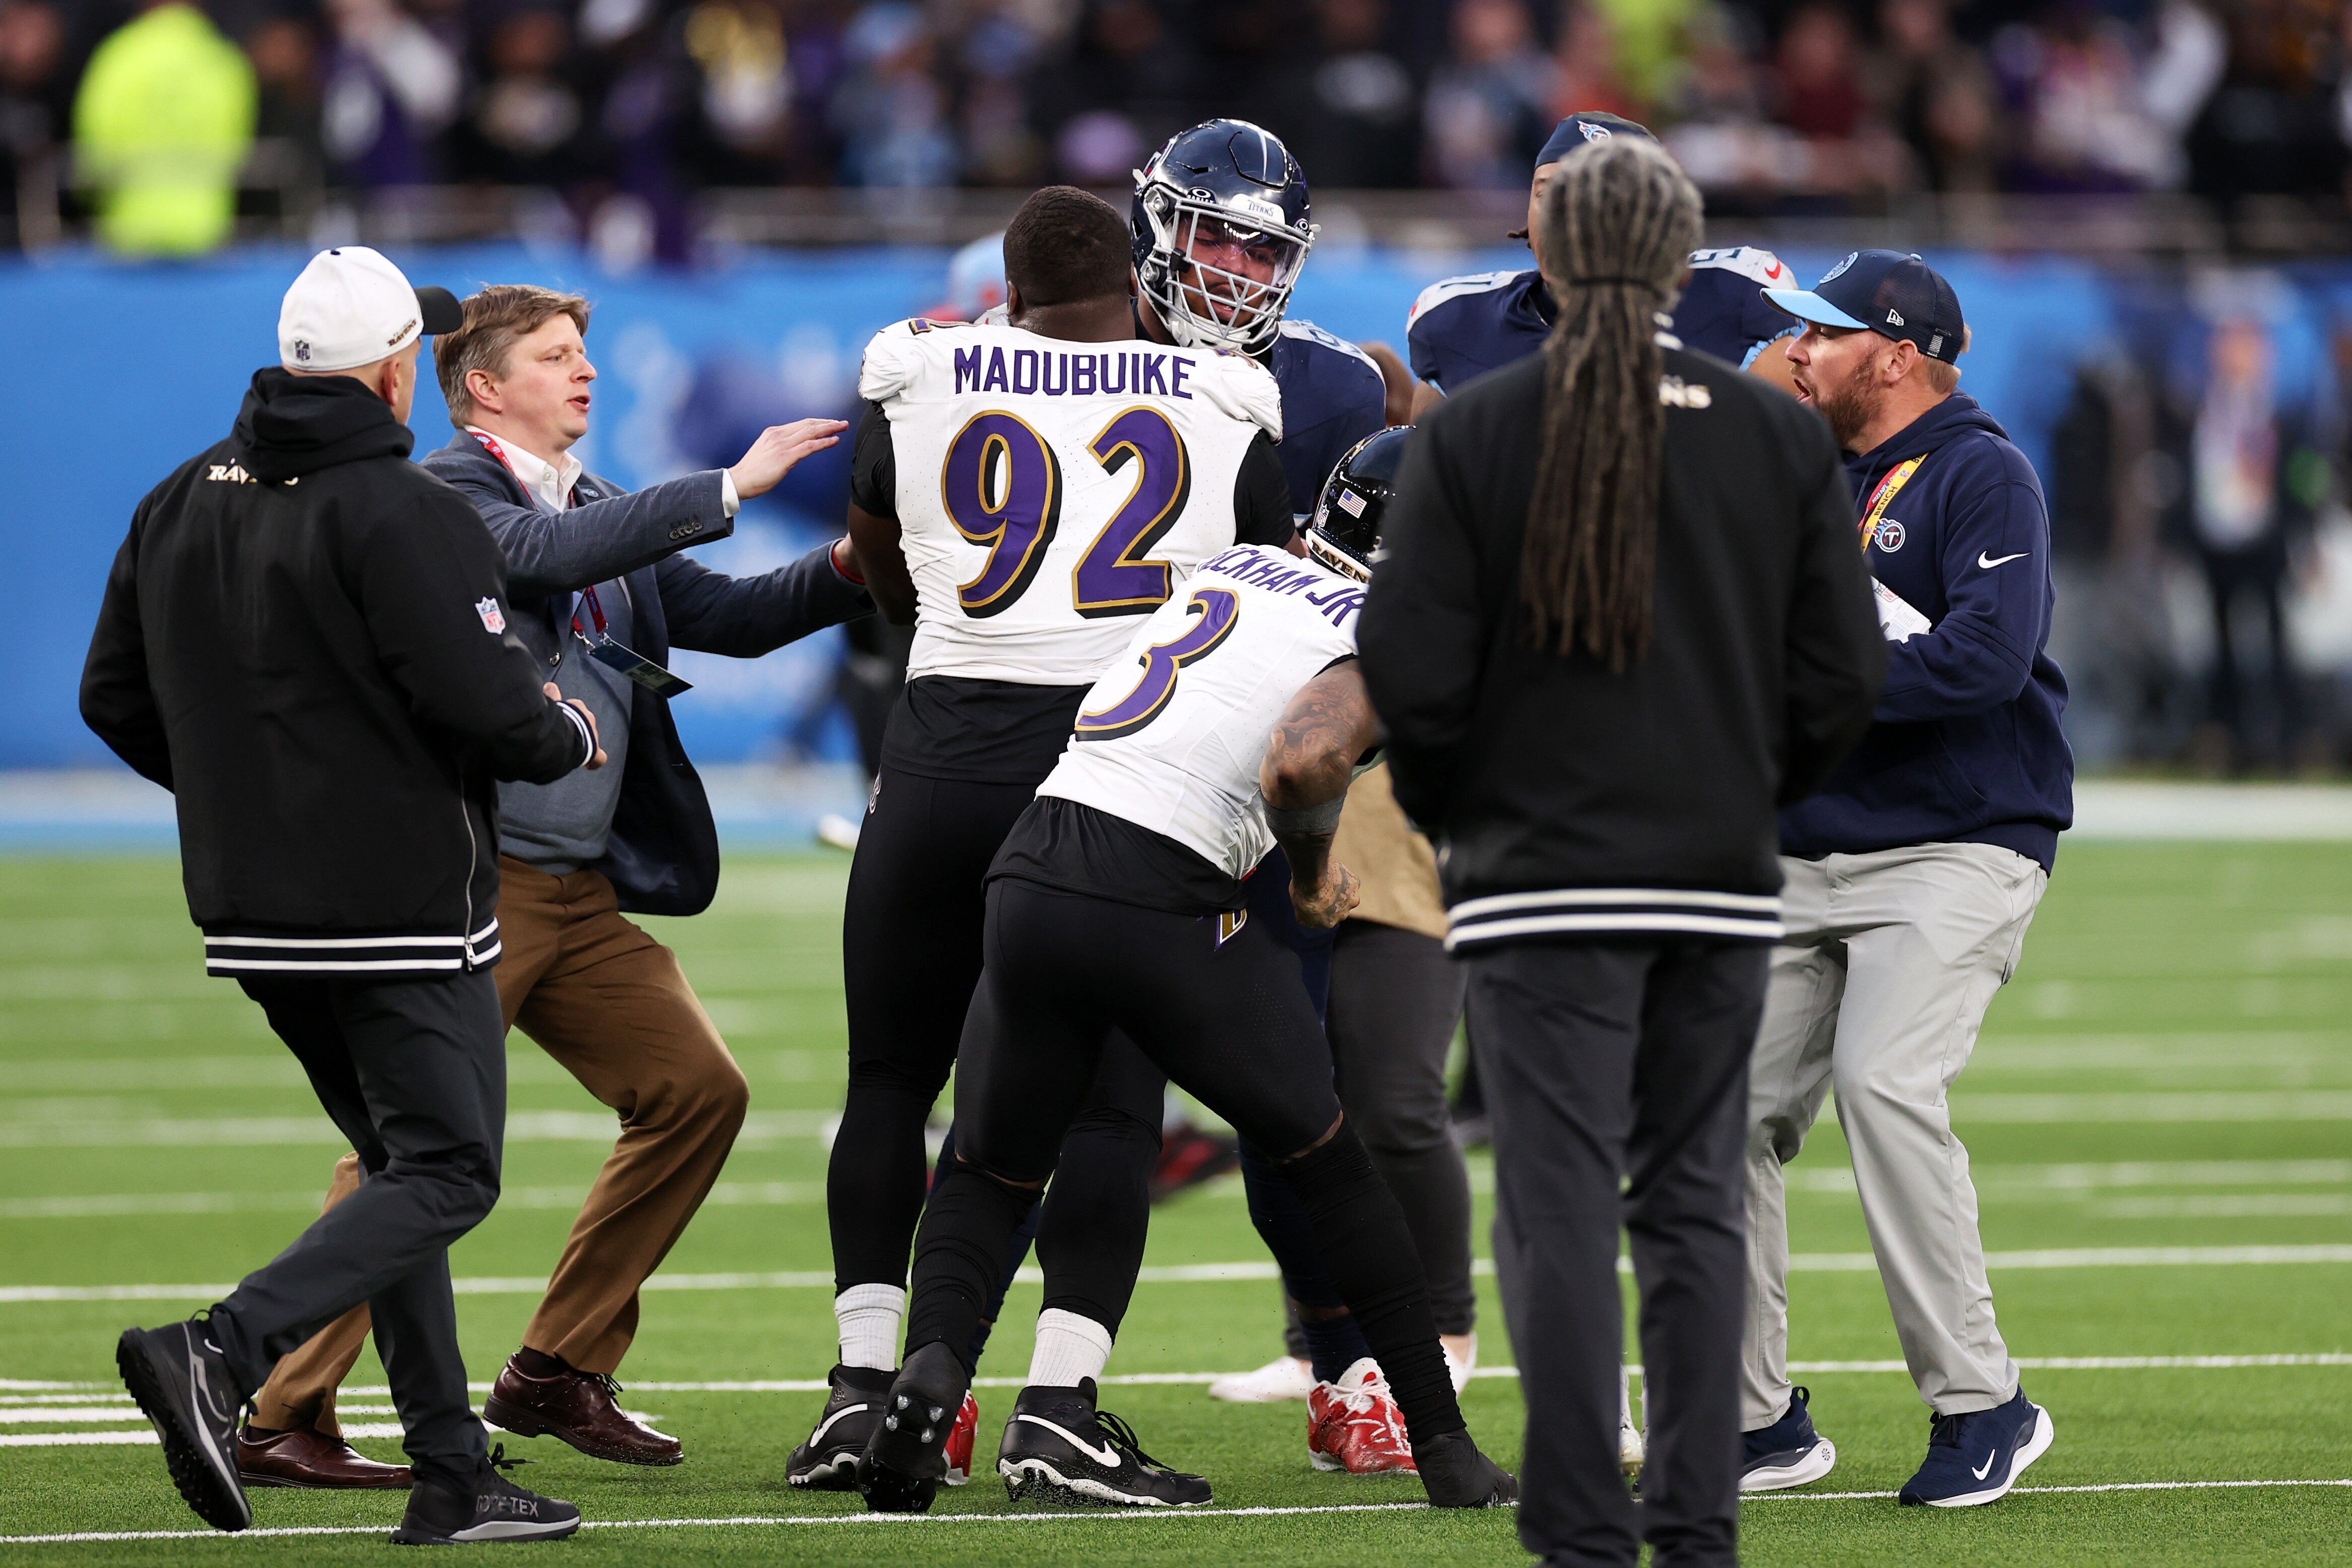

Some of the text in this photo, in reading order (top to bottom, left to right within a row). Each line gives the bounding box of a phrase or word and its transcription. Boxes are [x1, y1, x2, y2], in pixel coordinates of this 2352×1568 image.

[954, 345, 1196, 399] MADUBUIKE
[940, 404, 1191, 619] 92
[1874, 486, 1898, 515] BENCH
[1311, 538, 1371, 584] RAVEN
[1074, 587, 1241, 741] 3
